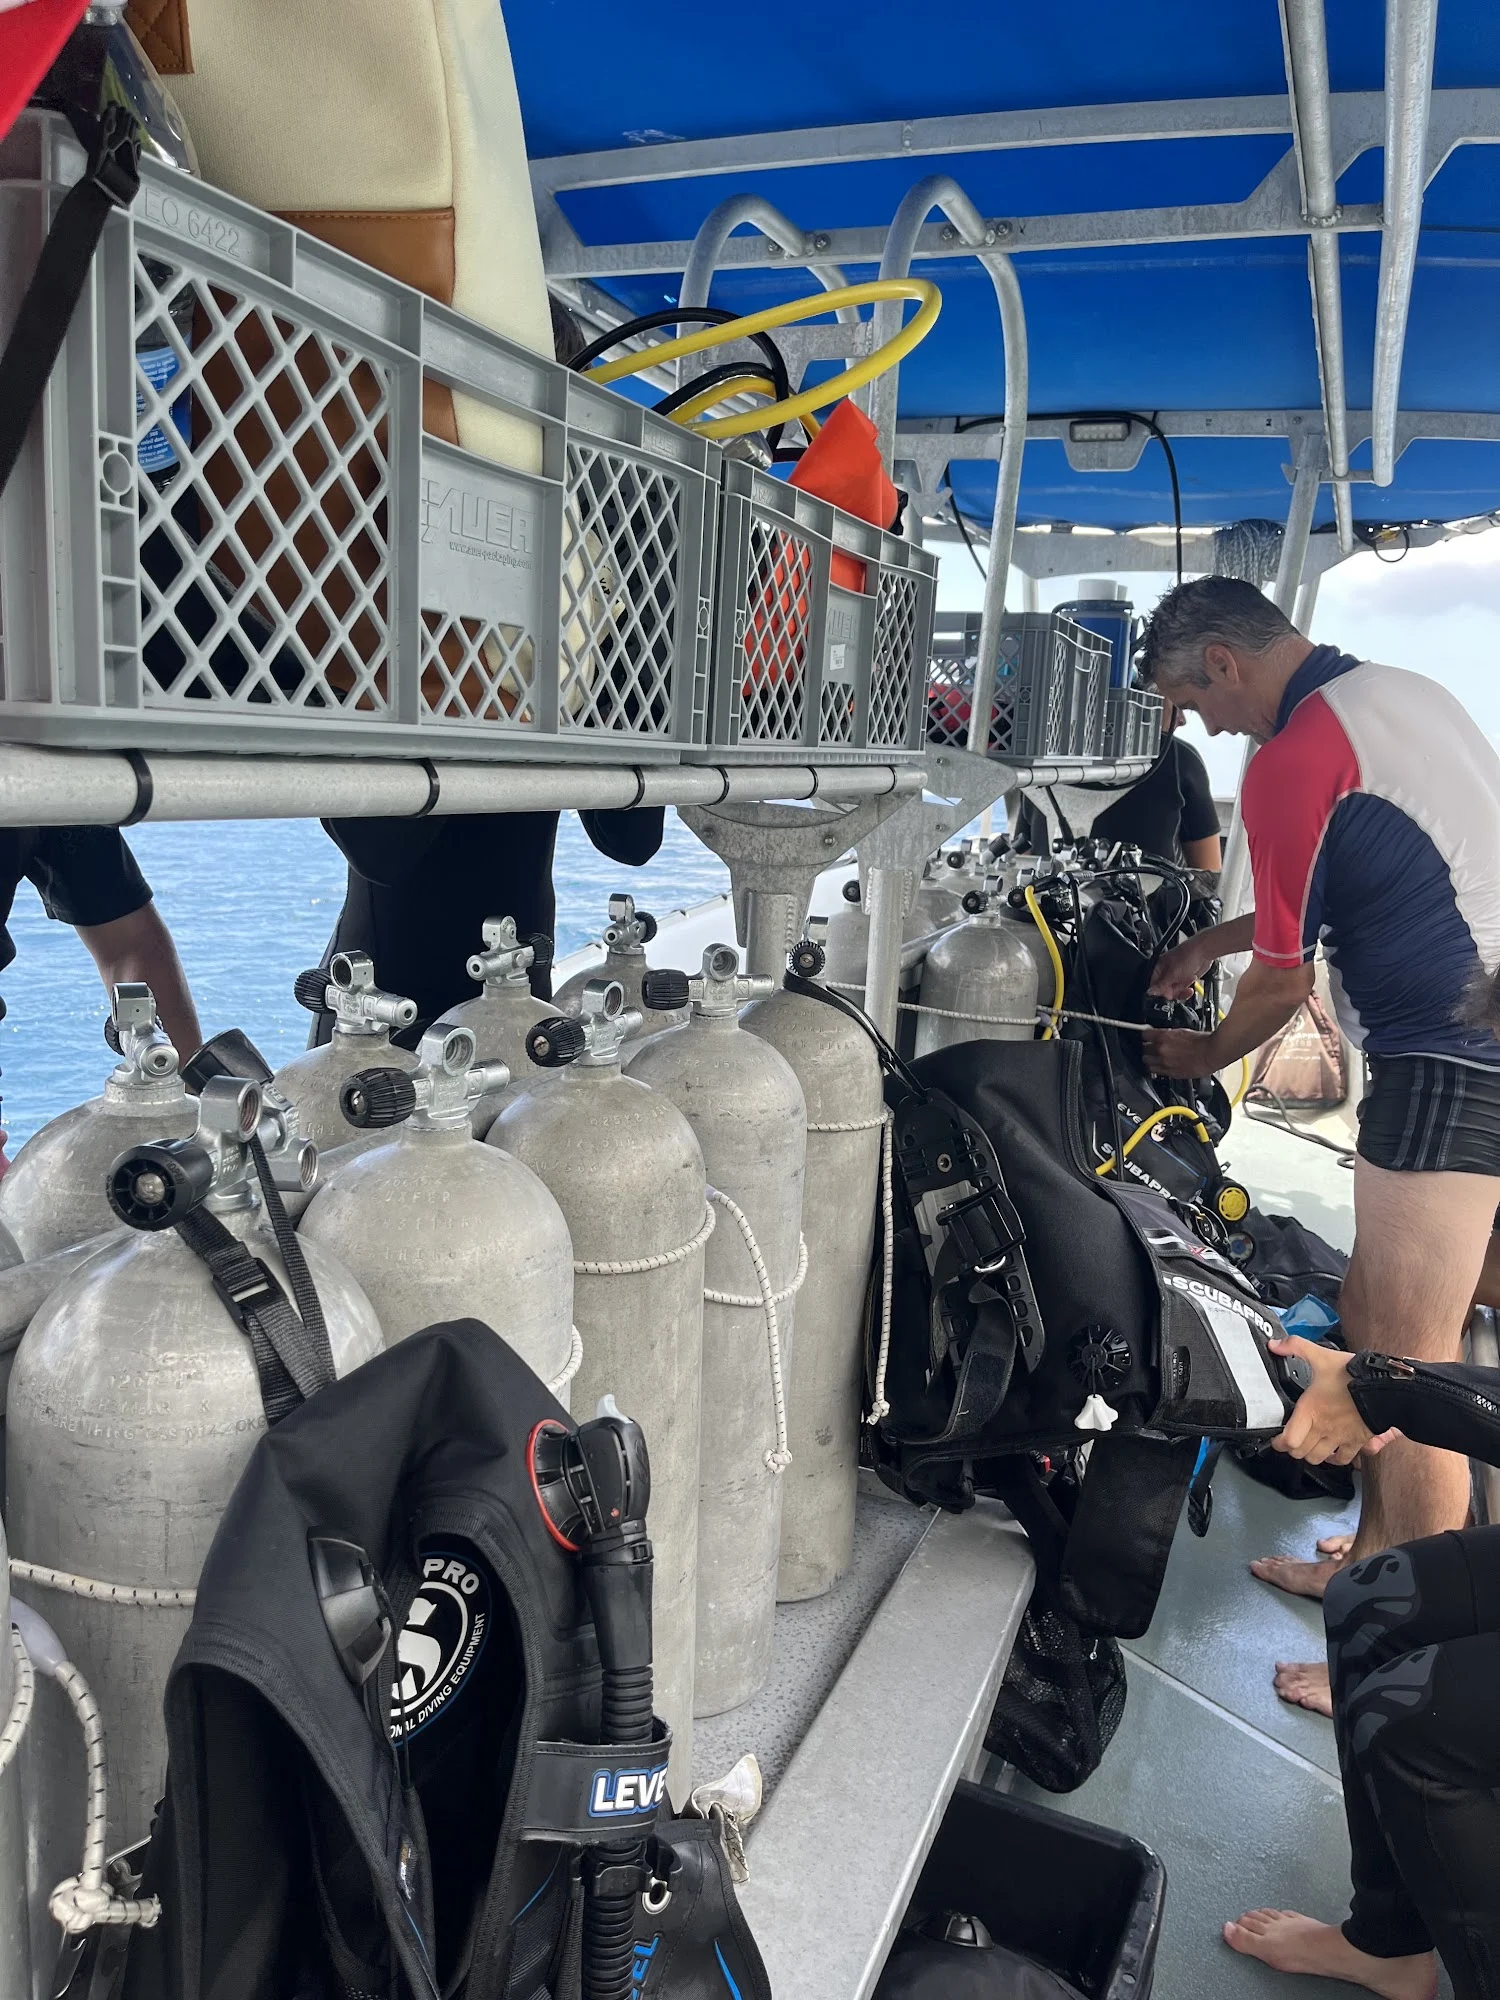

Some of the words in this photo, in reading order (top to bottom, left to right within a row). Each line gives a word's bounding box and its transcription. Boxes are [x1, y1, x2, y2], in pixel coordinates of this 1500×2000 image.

[188, 209, 240, 258] 6422
[1101, 1142, 1180, 1203] SUBAPR
[1172, 1276, 1274, 1338] SCUBAPRO
[450, 1612, 486, 1685] EQUIPMENT
[418, 1684, 453, 1724] DIVING
